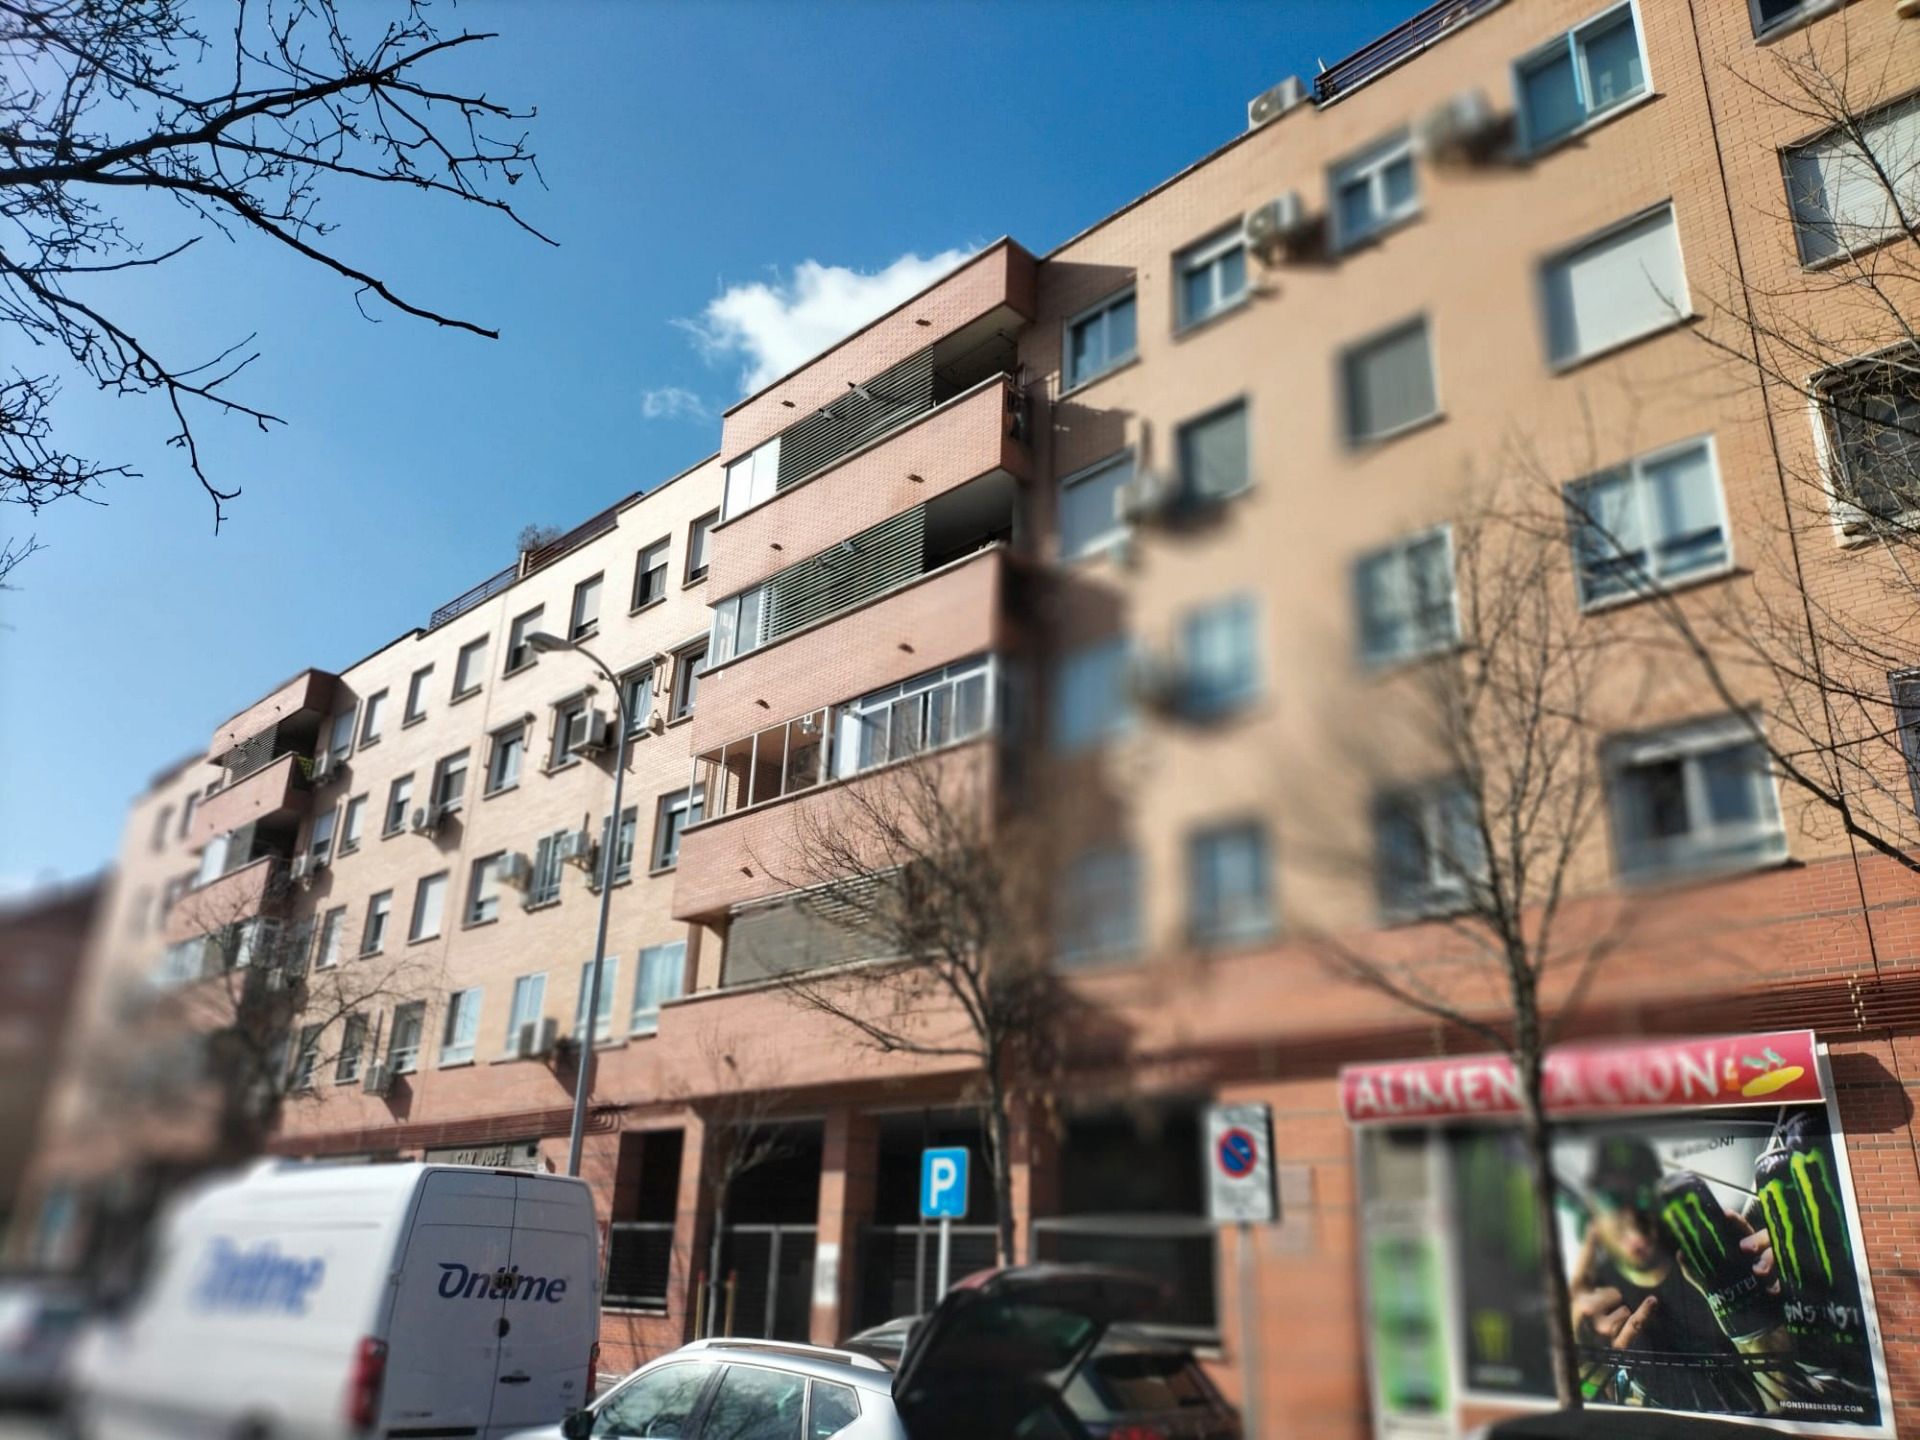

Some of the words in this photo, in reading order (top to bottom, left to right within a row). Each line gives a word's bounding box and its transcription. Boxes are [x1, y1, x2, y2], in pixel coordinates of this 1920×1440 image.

[1353, 1047, 1719, 1114] ALIMENACION
[456, 1151, 477, 1165] SAN
[481, 1150, 508, 1167] JOSE
[930, 1157, 957, 1208] P
[437, 1263, 567, 1303] Ontime
[1779, 1400, 1864, 1413] MONSTERENERGY.COM
